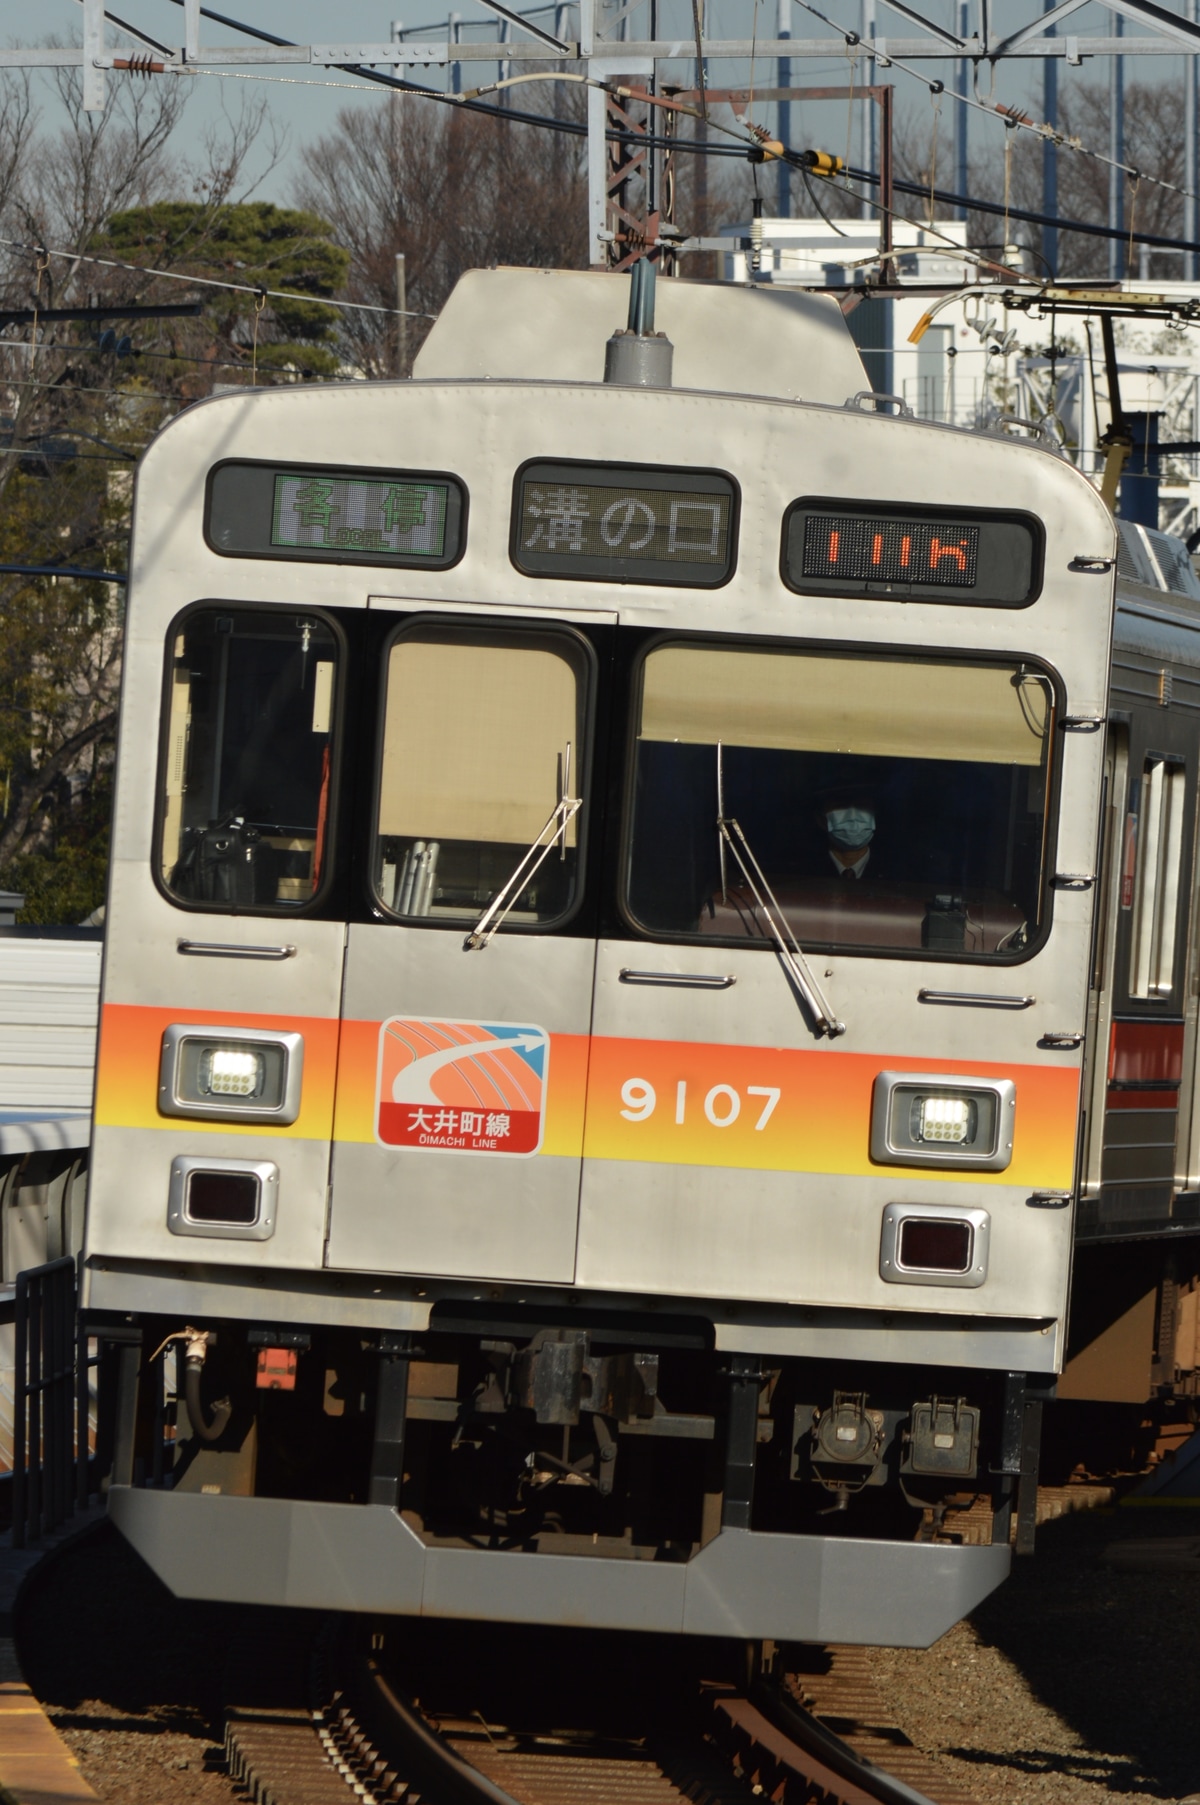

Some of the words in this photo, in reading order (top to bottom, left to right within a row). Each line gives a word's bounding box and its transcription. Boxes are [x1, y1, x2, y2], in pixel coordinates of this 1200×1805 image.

[293, 482, 428, 534] 各停
[524, 488, 721, 555] 溝の口
[407, 1108, 511, 1138] 大井町線
[620, 1077, 781, 1131] 9107
[472, 1139, 497, 1149] LINE
